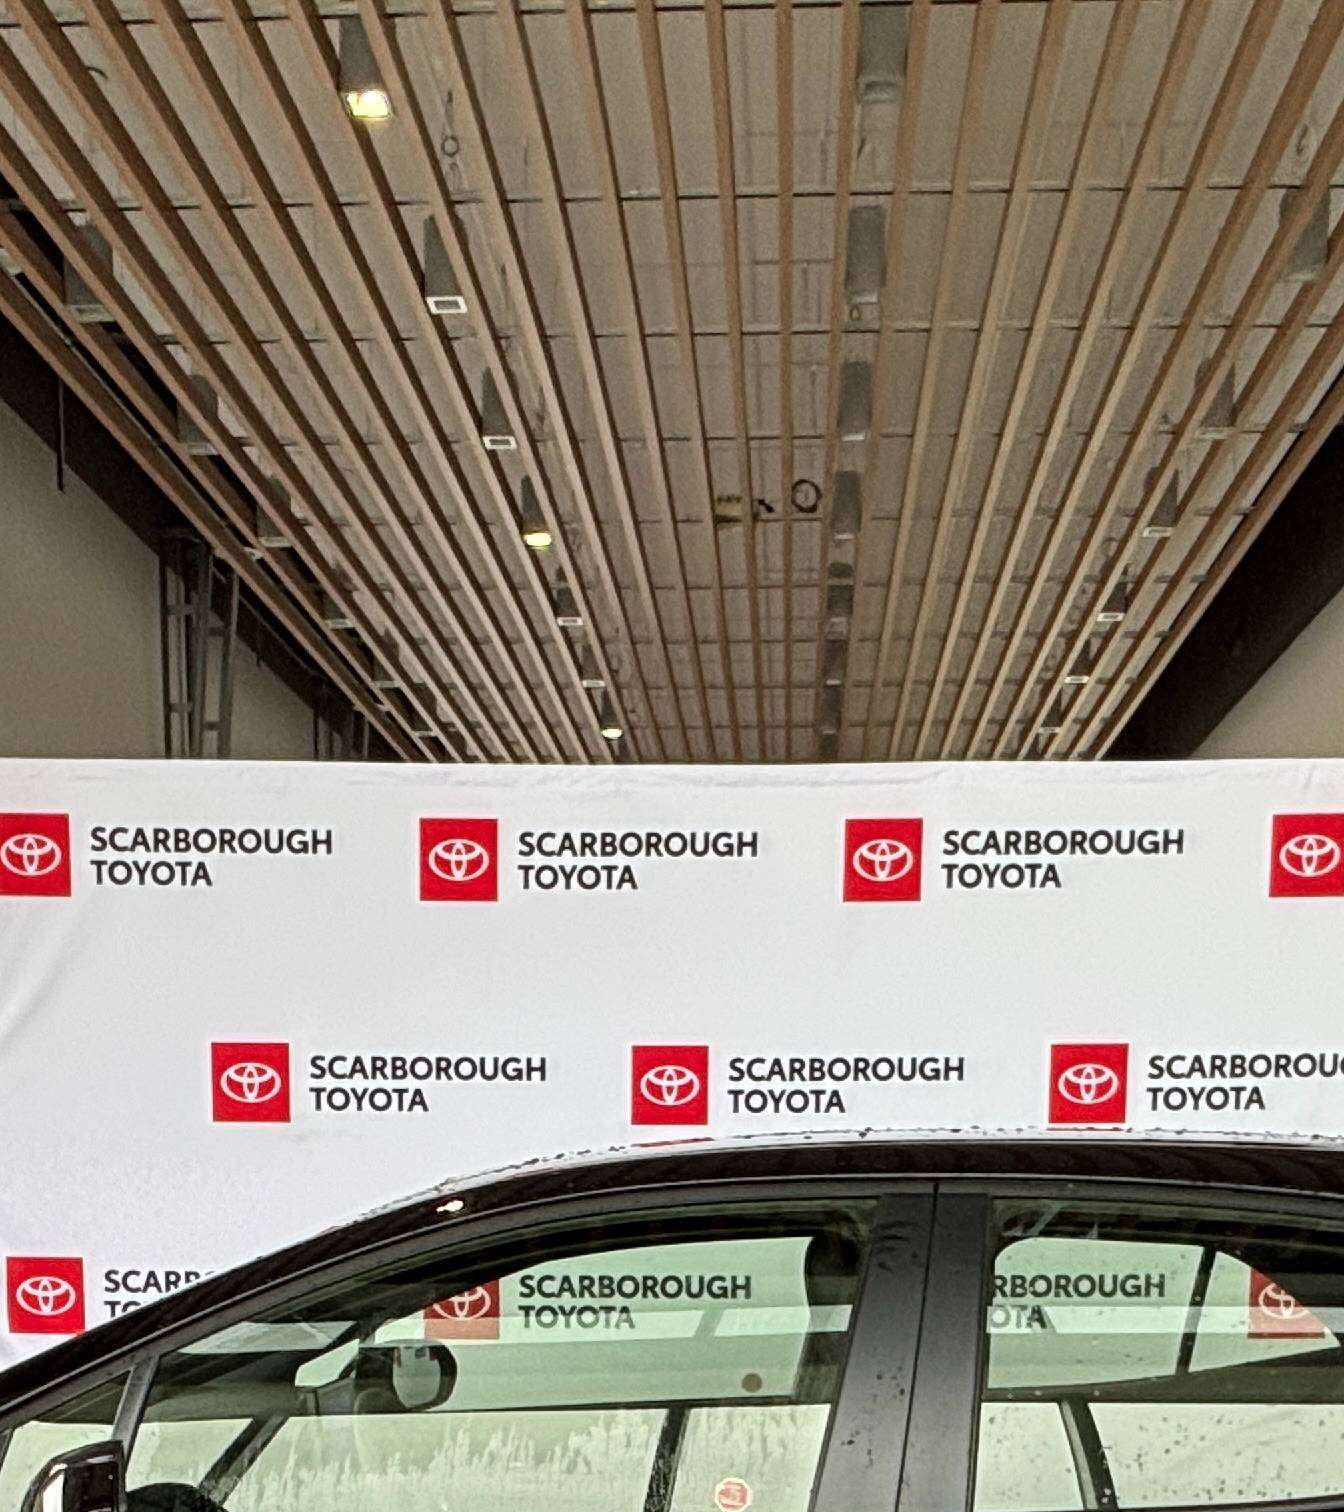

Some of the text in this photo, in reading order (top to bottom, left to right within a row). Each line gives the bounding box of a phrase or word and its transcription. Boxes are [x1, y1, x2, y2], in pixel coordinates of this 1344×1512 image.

[90, 826, 332, 855] SCARBOROUGH
[518, 831, 758, 858] SCARBOROUGH
[942, 829, 1184, 856] SCARBOROUGH
[90, 860, 213, 886] TOYOTA
[517, 864, 638, 890] TOYOTA
[941, 863, 1061, 889] TOYOTA
[309, 1055, 547, 1082] SCARBOROUGH
[728, 1056, 964, 1082] SCARBOROUGH
[308, 1087, 429, 1112] TOYOTA
[727, 1089, 846, 1114] TOYOTA
[1146, 1086, 1266, 1111] TOYOTA
[103, 1268, 216, 1294] SCARB
[518, 1274, 752, 1300] SCARBOROUGH
[992, 1273, 1166, 1299] RBOROUGH
[517, 1304, 636, 1330] TOYOTA
[989, 1304, 1048, 1330] OTA
